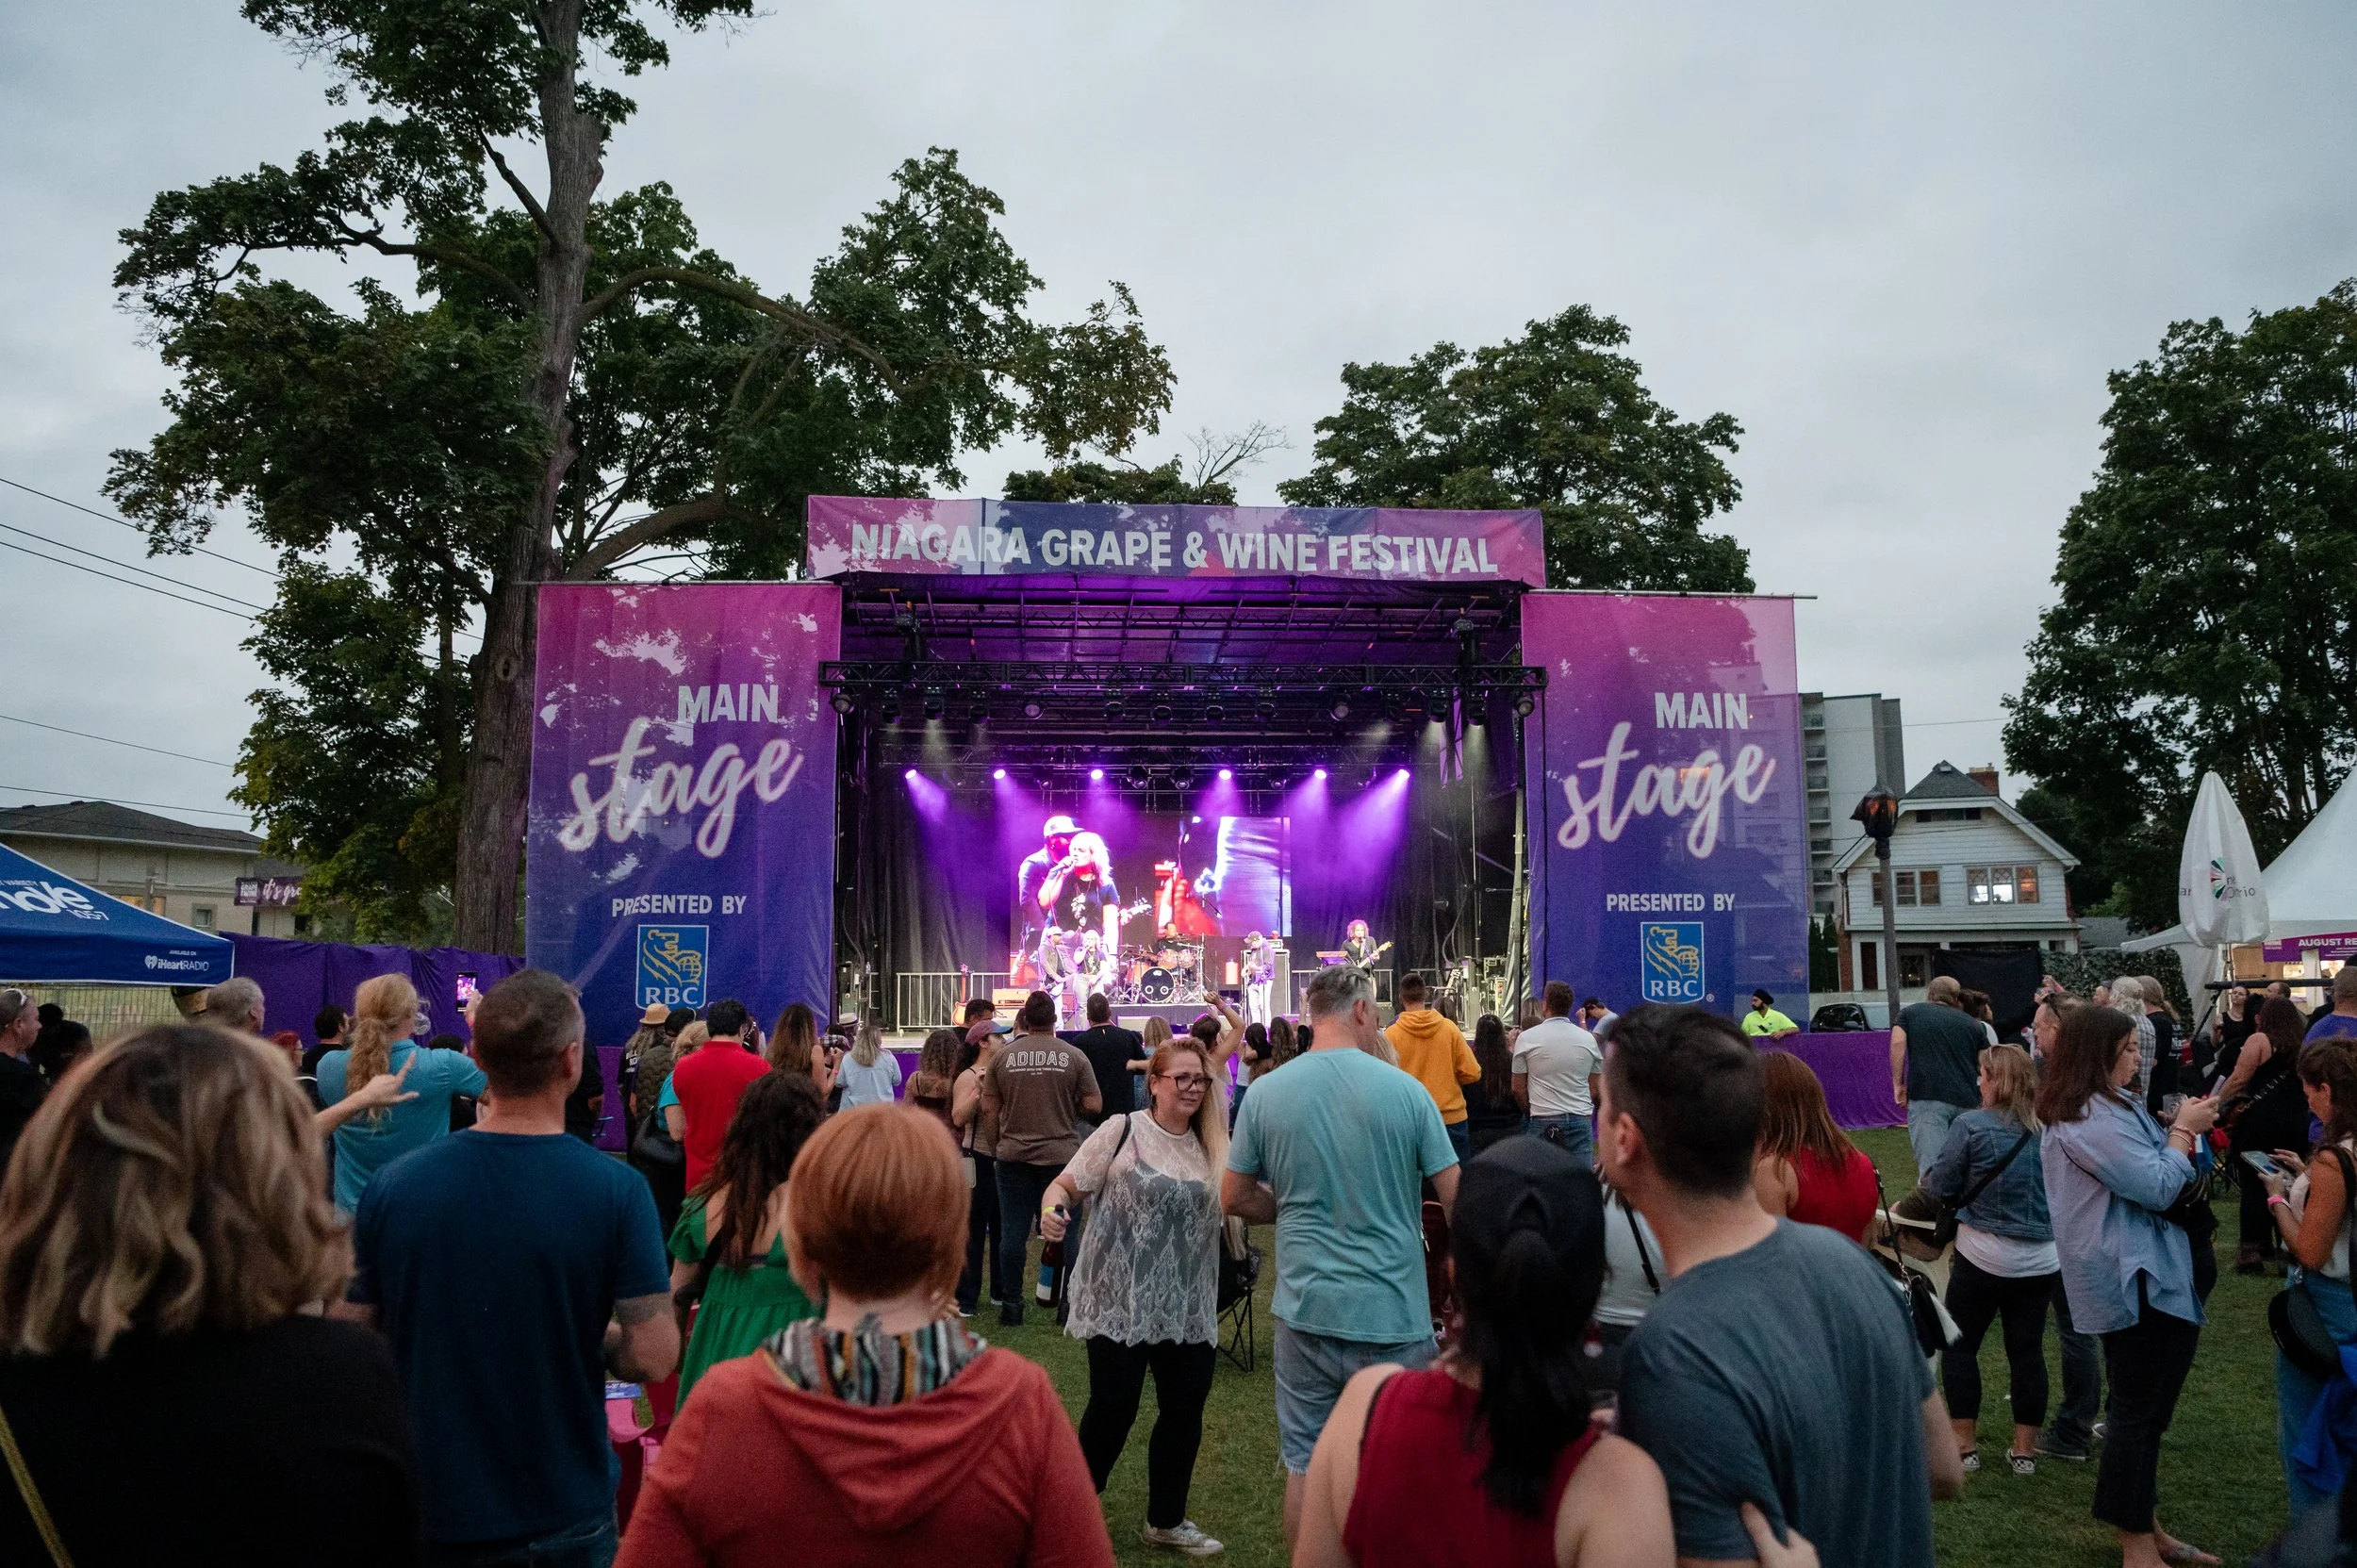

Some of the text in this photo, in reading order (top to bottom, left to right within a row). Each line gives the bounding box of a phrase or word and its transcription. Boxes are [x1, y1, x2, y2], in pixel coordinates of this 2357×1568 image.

[851, 523, 1498, 573] NIAGARA GRAPE & WINE FESTIVAL
[678, 684, 779, 723] MAIN
[1655, 692, 1748, 730] MAIN
[558, 717, 804, 858] stage
[1558, 721, 1775, 859] stage
[612, 895, 747, 916] PRESENTED BY
[1607, 894, 1735, 912] PRESENTED BY
[2298, 938, 2342, 947] AUGUST
[645, 986, 698, 1005] RBC
[1651, 980, 1698, 997] RBC
[1005, 1050, 1069, 1067] ADIDAS
